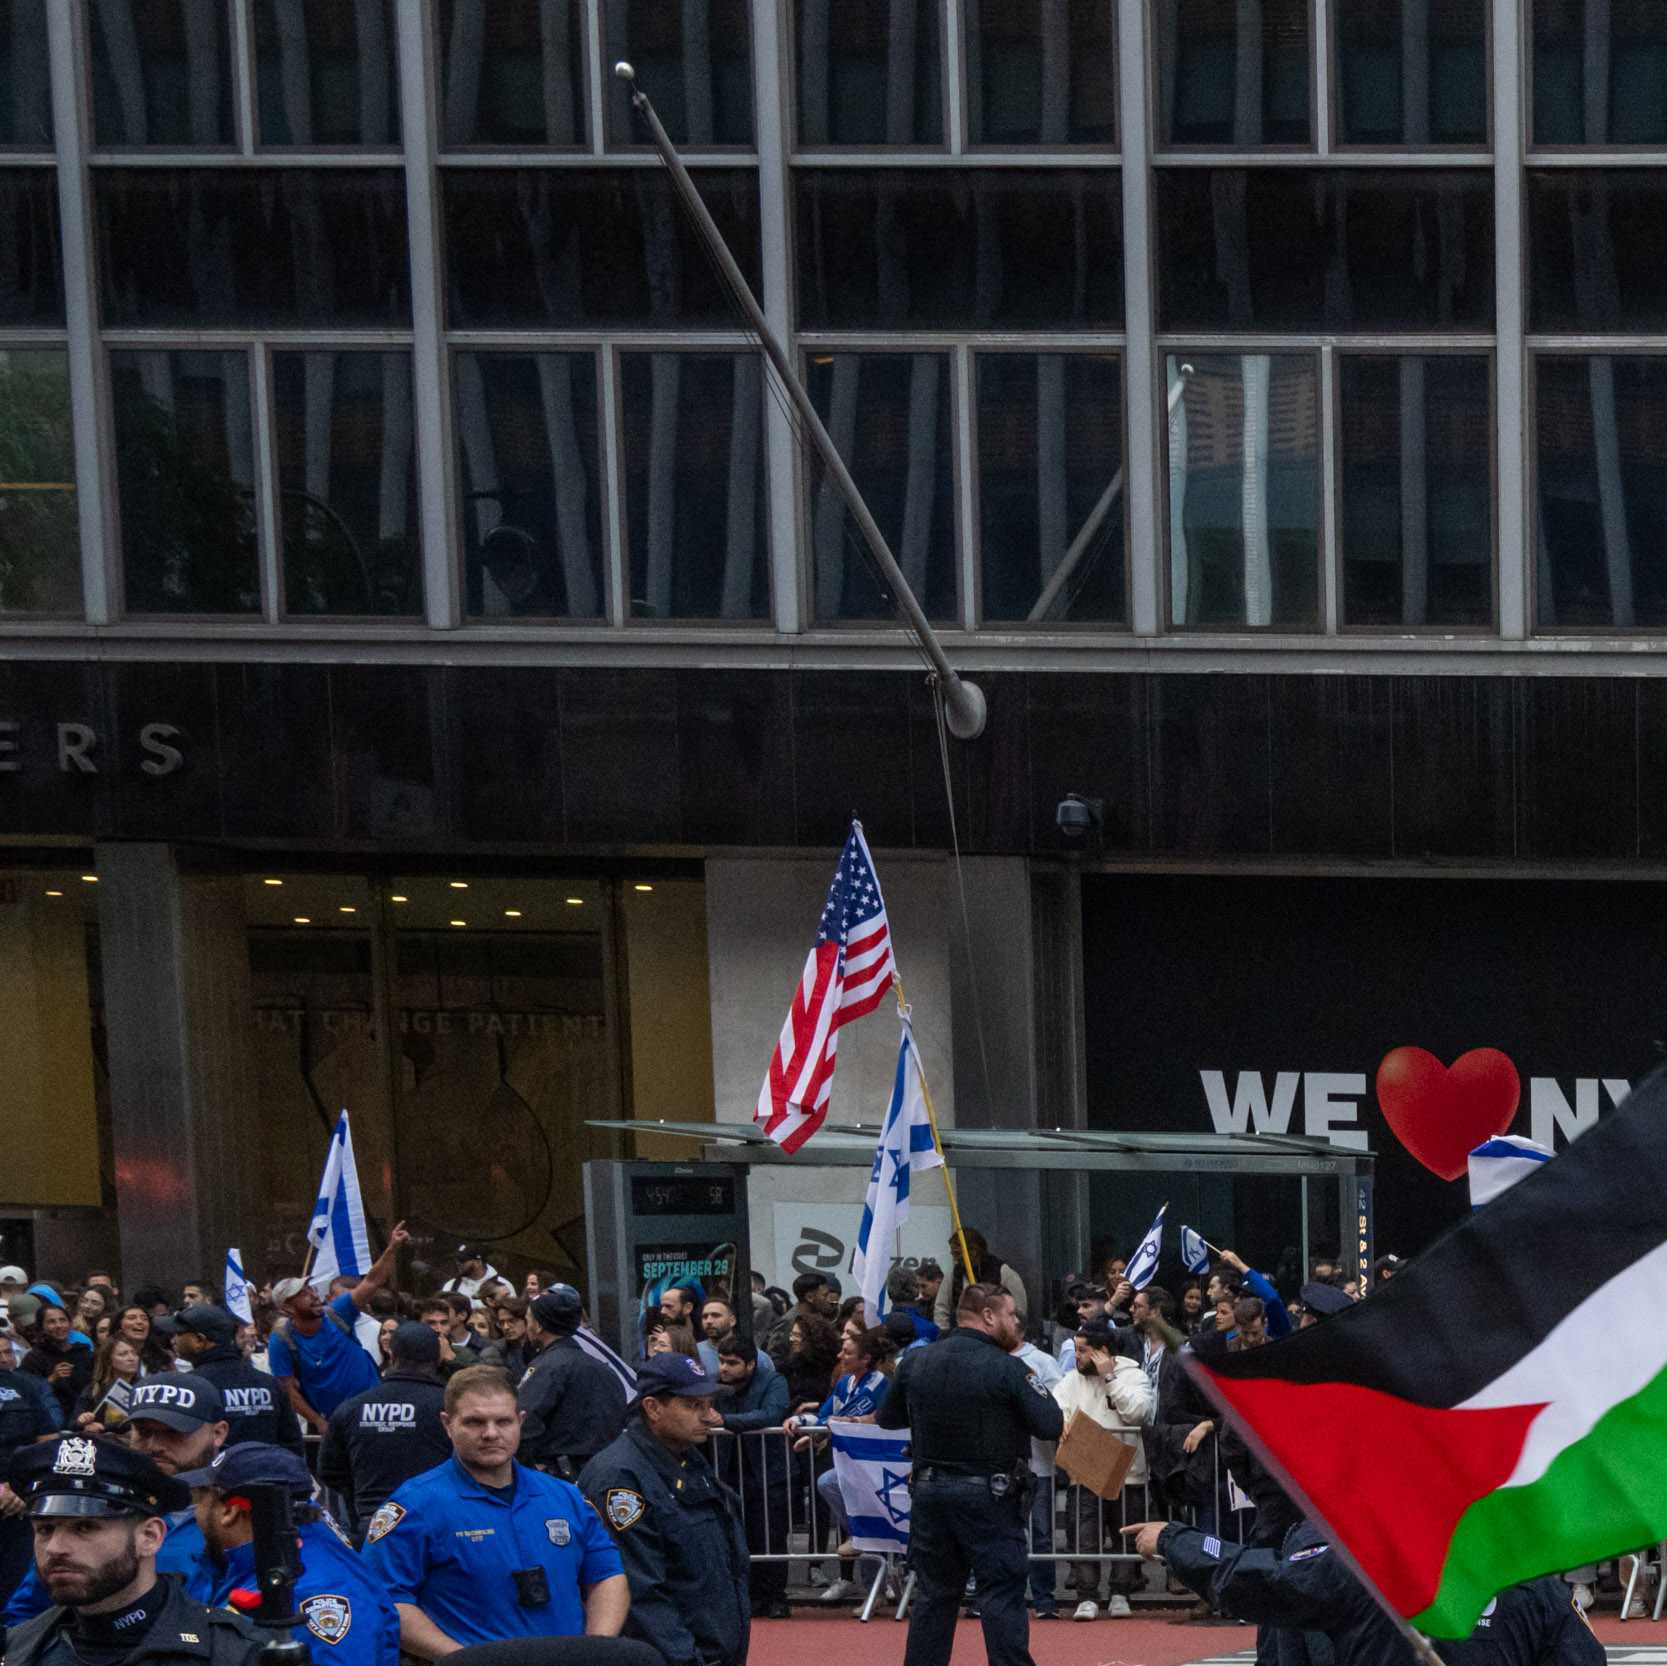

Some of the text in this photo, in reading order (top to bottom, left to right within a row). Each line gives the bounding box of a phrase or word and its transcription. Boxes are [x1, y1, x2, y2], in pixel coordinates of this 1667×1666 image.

[1199, 1069, 1369, 1151] WE
[644, 1260, 713, 1280] SEPTEMBER
[131, 1384, 197, 1409] NYPD
[225, 1387, 272, 1407] NYPD
[362, 1403, 416, 1422] NYPD
[113, 1608, 148, 1631] NYPD
